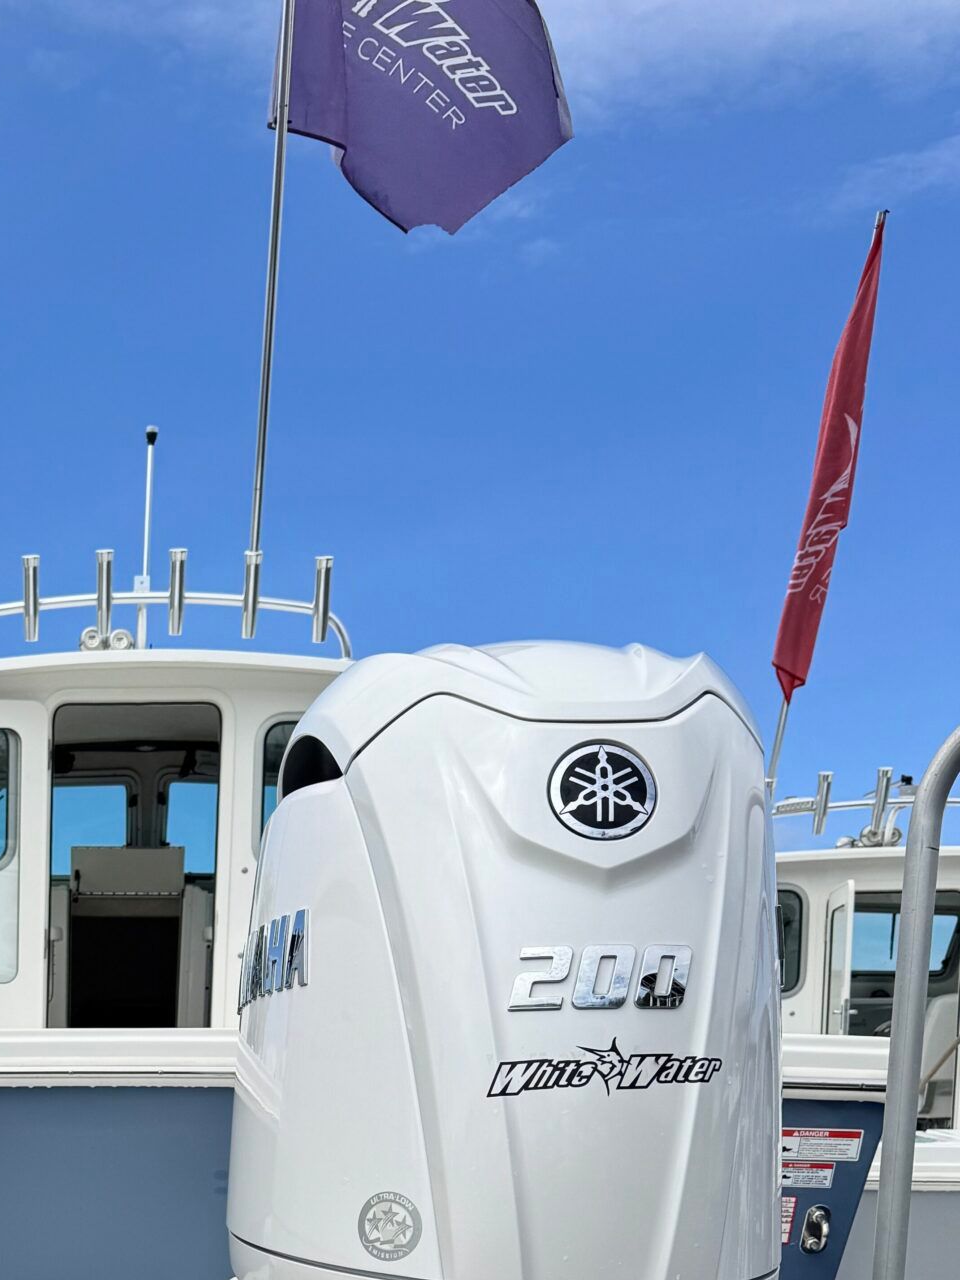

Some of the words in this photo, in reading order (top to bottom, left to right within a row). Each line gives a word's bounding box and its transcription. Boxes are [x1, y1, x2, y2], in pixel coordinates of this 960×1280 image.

[358, 37, 466, 130] CENTER
[373, 0, 517, 115] Water
[507, 943, 693, 1012] 200
[486, 1058, 597, 1098] White
[616, 1053, 722, 1090] Water
